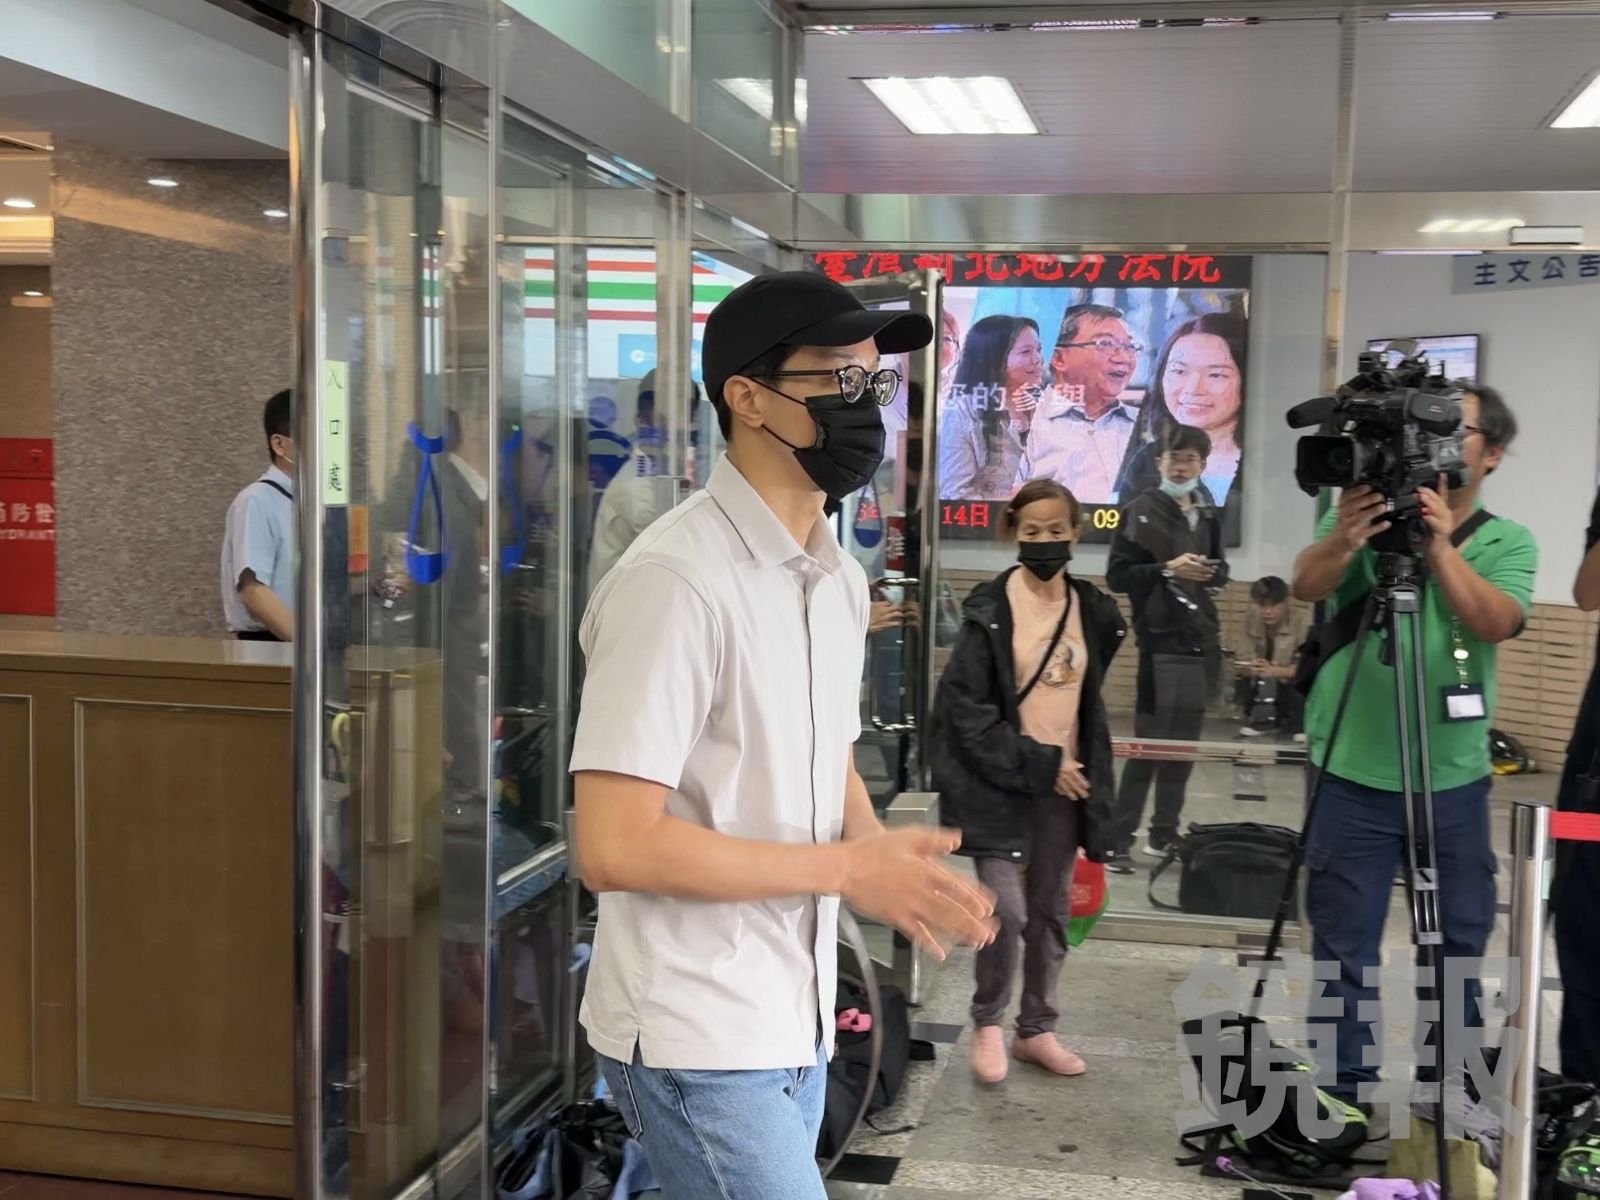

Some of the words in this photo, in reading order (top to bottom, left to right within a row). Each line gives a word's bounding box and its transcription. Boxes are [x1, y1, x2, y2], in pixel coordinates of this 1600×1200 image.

[1474, 254, 1600, 285] 主文公告
[942, 503, 989, 528] 14日
[1092, 509, 1121, 530] 09
